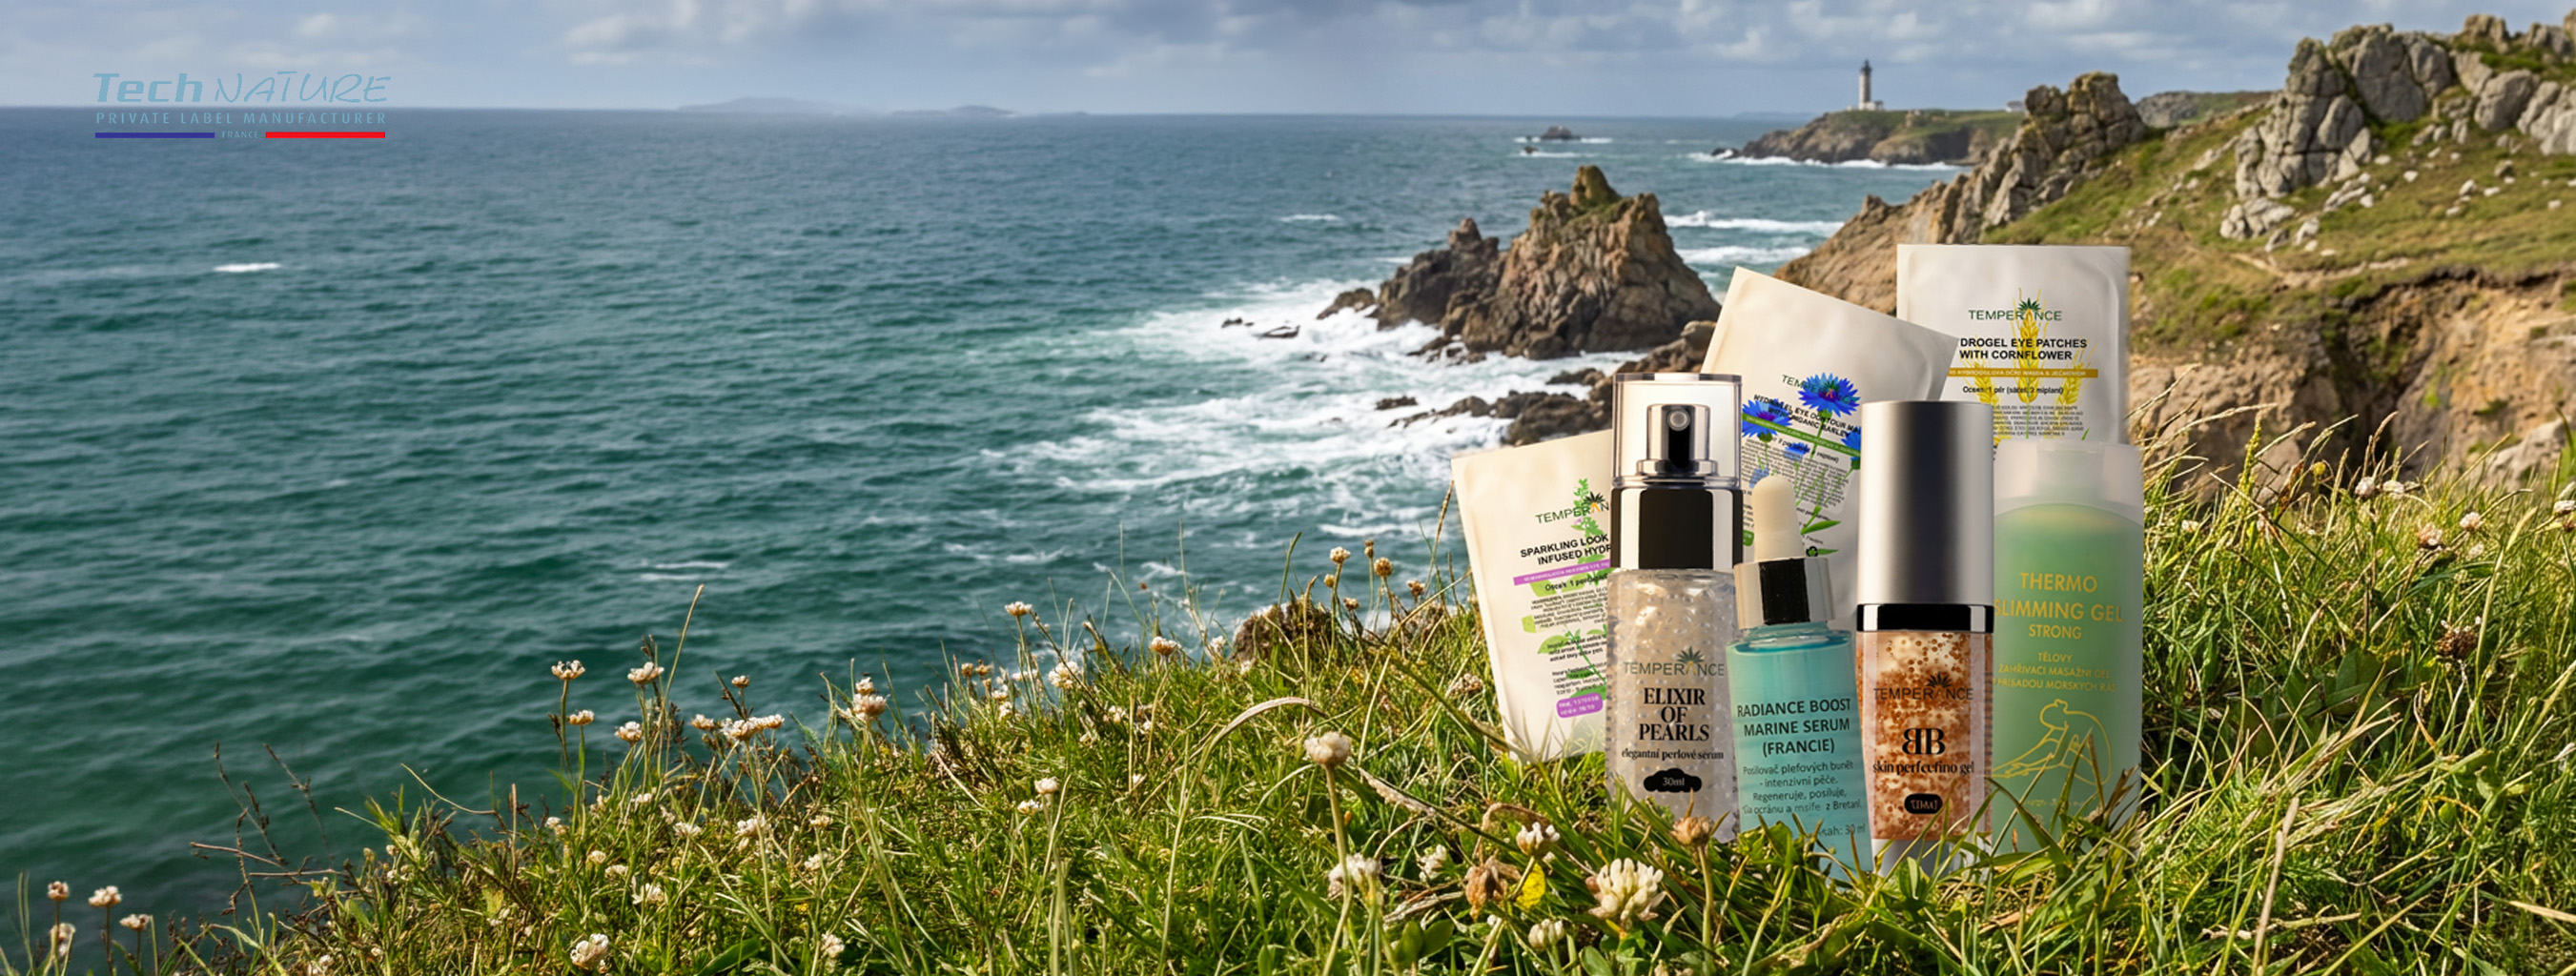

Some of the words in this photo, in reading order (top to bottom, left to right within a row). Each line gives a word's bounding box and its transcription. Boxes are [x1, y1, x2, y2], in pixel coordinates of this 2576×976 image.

[1969, 309, 2062, 321] TEMPERANCE
[2011, 337, 2034, 347] EYE
[2035, 338, 2087, 348] PATCHES
[1959, 350, 1989, 359] WITH
[1992, 350, 2073, 360] CORNFLOWER
[1520, 539, 1578, 558] SPARKLING
[1580, 534, 1609, 546] LOOK
[1538, 550, 1583, 565] INFUSED
[2020, 572, 2097, 593] THERMO
[1993, 599, 2084, 620] SLIMMING
[2091, 603, 2123, 622] GEL
[2029, 624, 2082, 640] STRONG
[1623, 661, 1725, 676] TEMPERANCE
[1644, 687, 1706, 705] ELIXIR
[1873, 687, 1974, 701] TEMPERANCE
[1661, 706, 1688, 723] OF
[1737, 701, 1806, 718] RADIANCE
[1809, 699, 1851, 712] BOOST
[1639, 723, 1709, 742] PEARLS
[1744, 721, 1799, 737] MARINE
[1803, 718, 1850, 732] SERUM
[1763, 738, 1835, 758] (FRANCIE)
[1872, 760, 1894, 773] skin
[1663, 777, 1685, 786] 30ml
[1819, 824, 1843, 837] sah:
